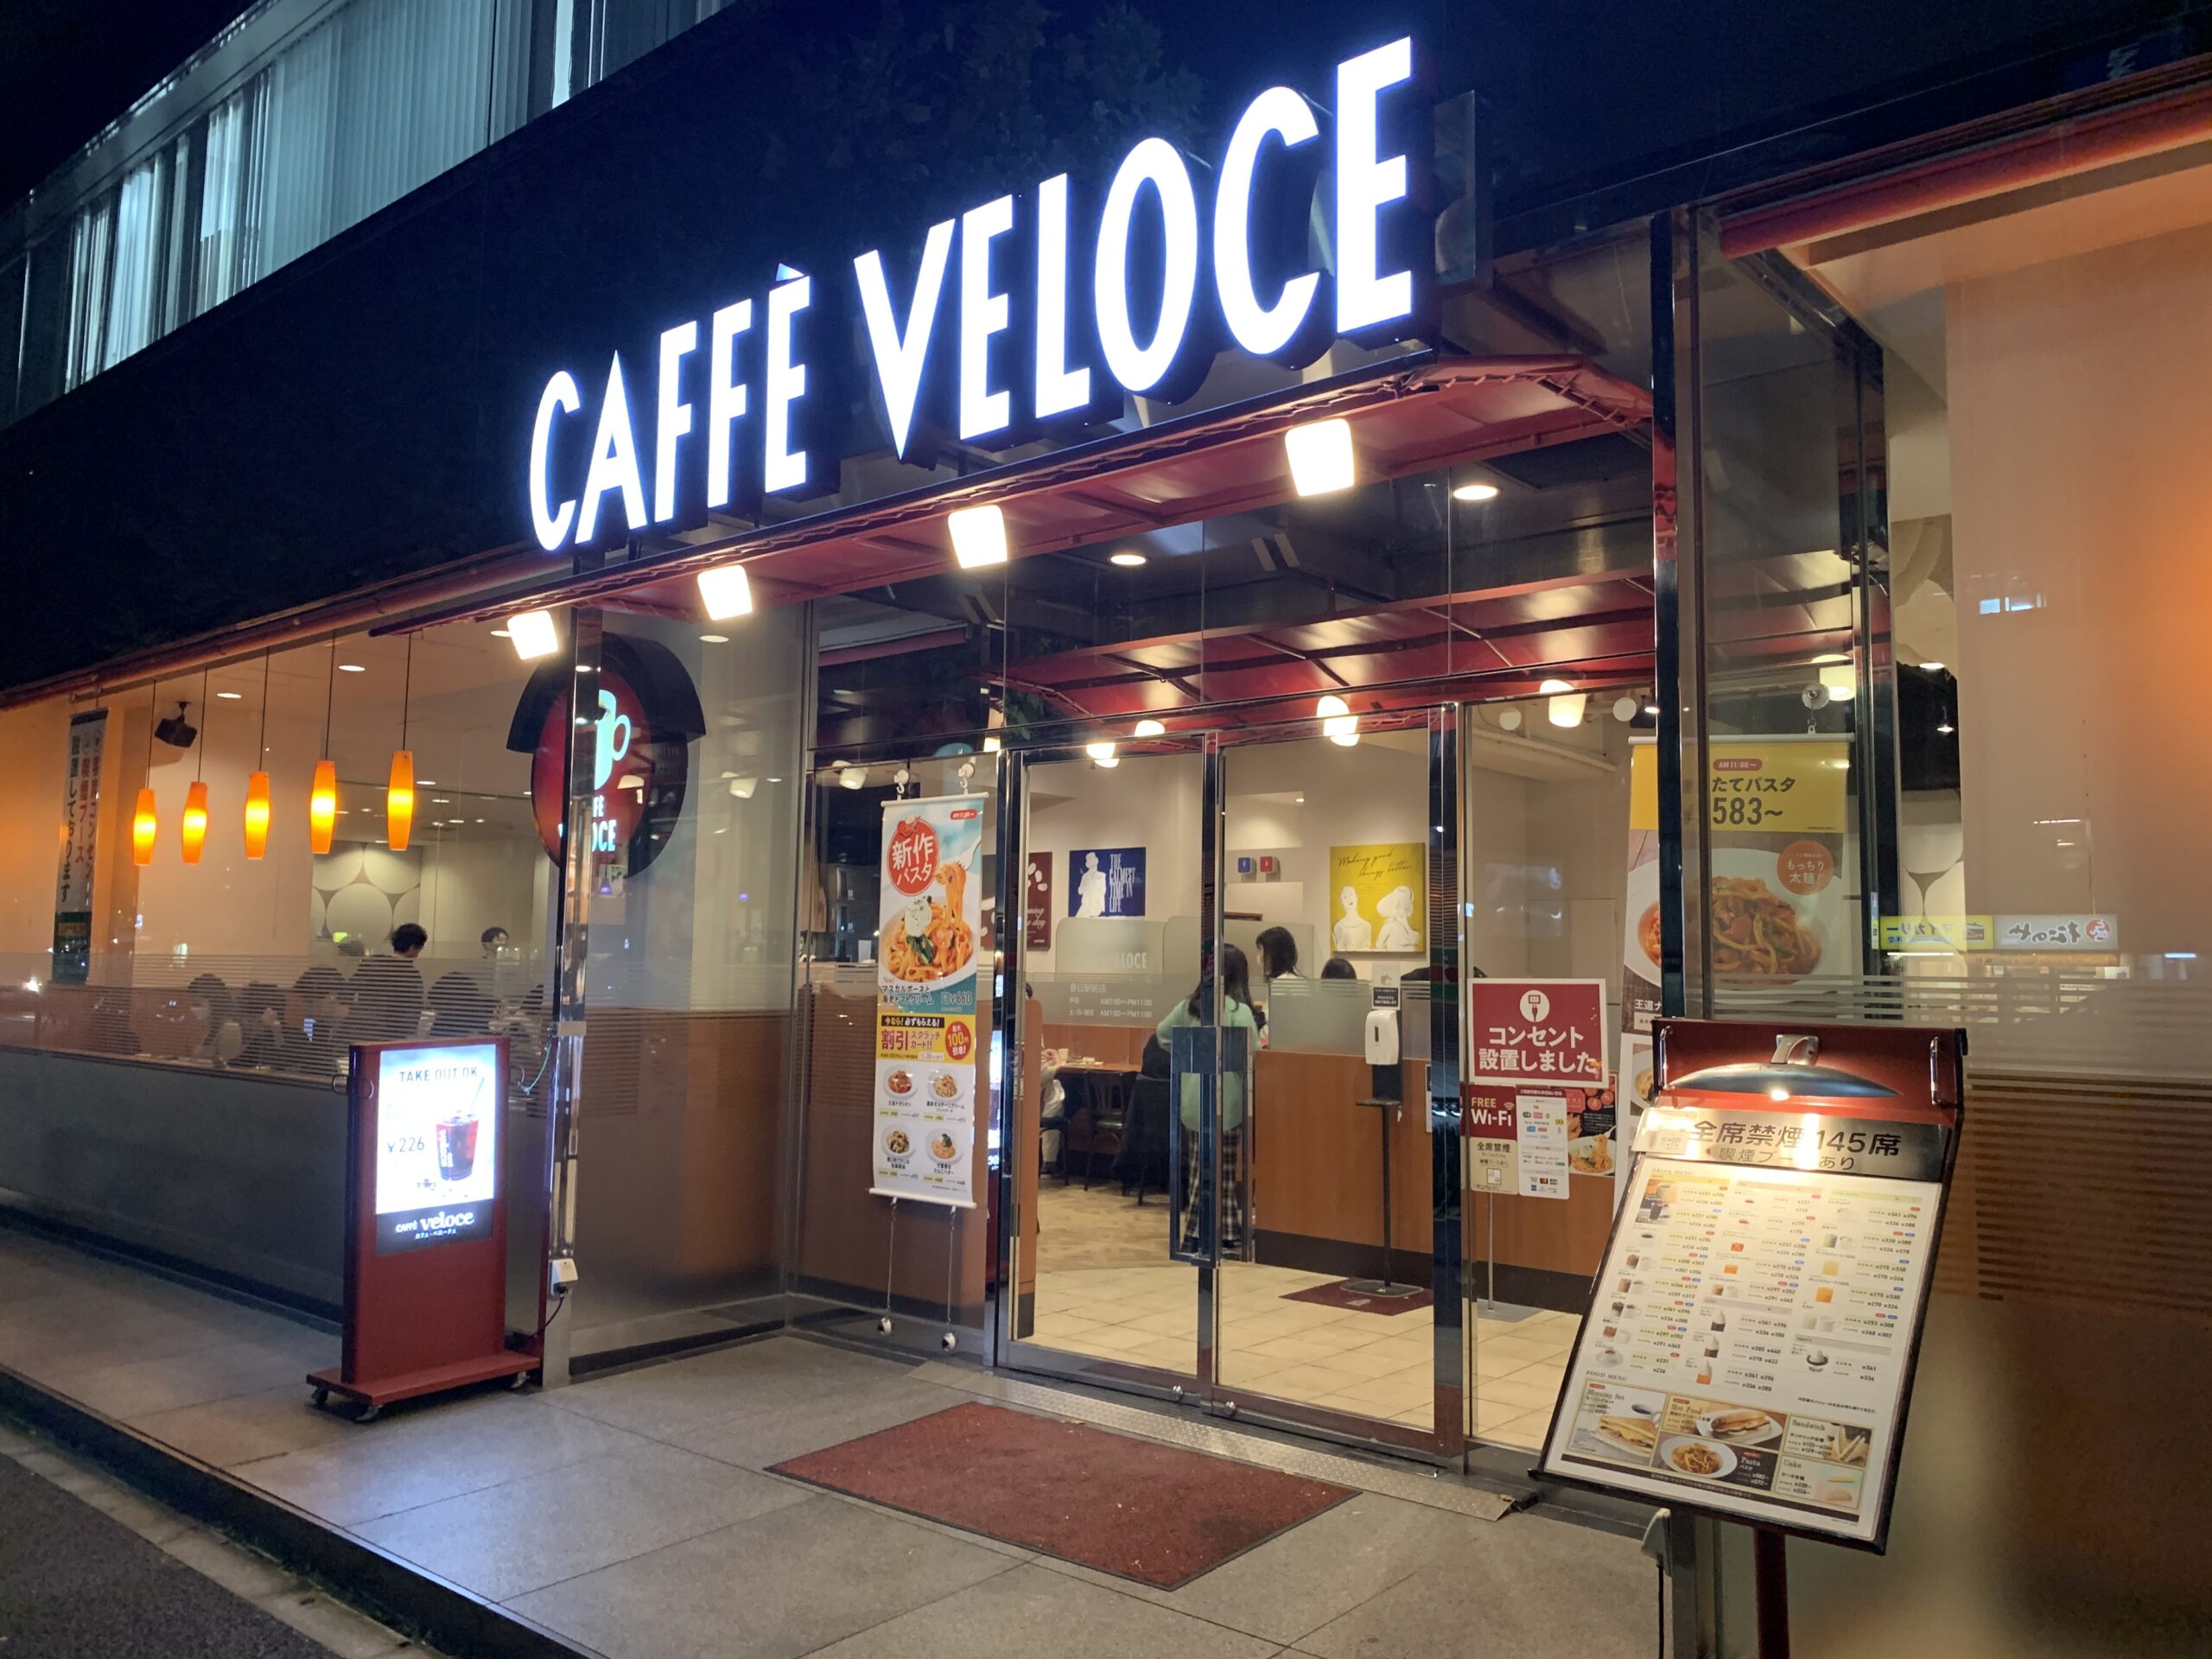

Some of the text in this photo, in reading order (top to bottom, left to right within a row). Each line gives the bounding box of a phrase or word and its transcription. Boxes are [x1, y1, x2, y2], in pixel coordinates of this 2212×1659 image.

[529, 35, 1412, 551] CAFFÈ VELOCE
[85, 756, 101, 900] 客席コンセン
[892, 833, 934, 870] 新作
[1109, 854, 1122, 868] THE
[1787, 859, 1825, 872] もっちり
[897, 861, 932, 887] パスタ
[1109, 898, 1122, 912] LIFE
[881, 985, 931, 995] マスカルポーネと
[882, 994, 933, 1005] 海老トマトクリーム
[881, 1029, 908, 1052] 割引
[911, 1030, 941, 1041] スクラッチ
[1489, 1026, 1584, 1048] コンセント
[1478, 1048, 1597, 1073] 設置しました
[399, 1066, 478, 1083] TAKE OUT OK
[1471, 1097, 1497, 1108] FREE
[387, 1136, 425, 1154] ¥226
[1477, 1141, 1511, 1153] 全席禁煙
[1816, 1129, 1902, 1156] 145席
[1719, 1147, 1855, 1171] 喫煙ブーあり
[1791, 1419, 1826, 1432] Sandwich
[1741, 1457, 1761, 1467] Pasta
[1783, 1459, 1802, 1469] Cake
